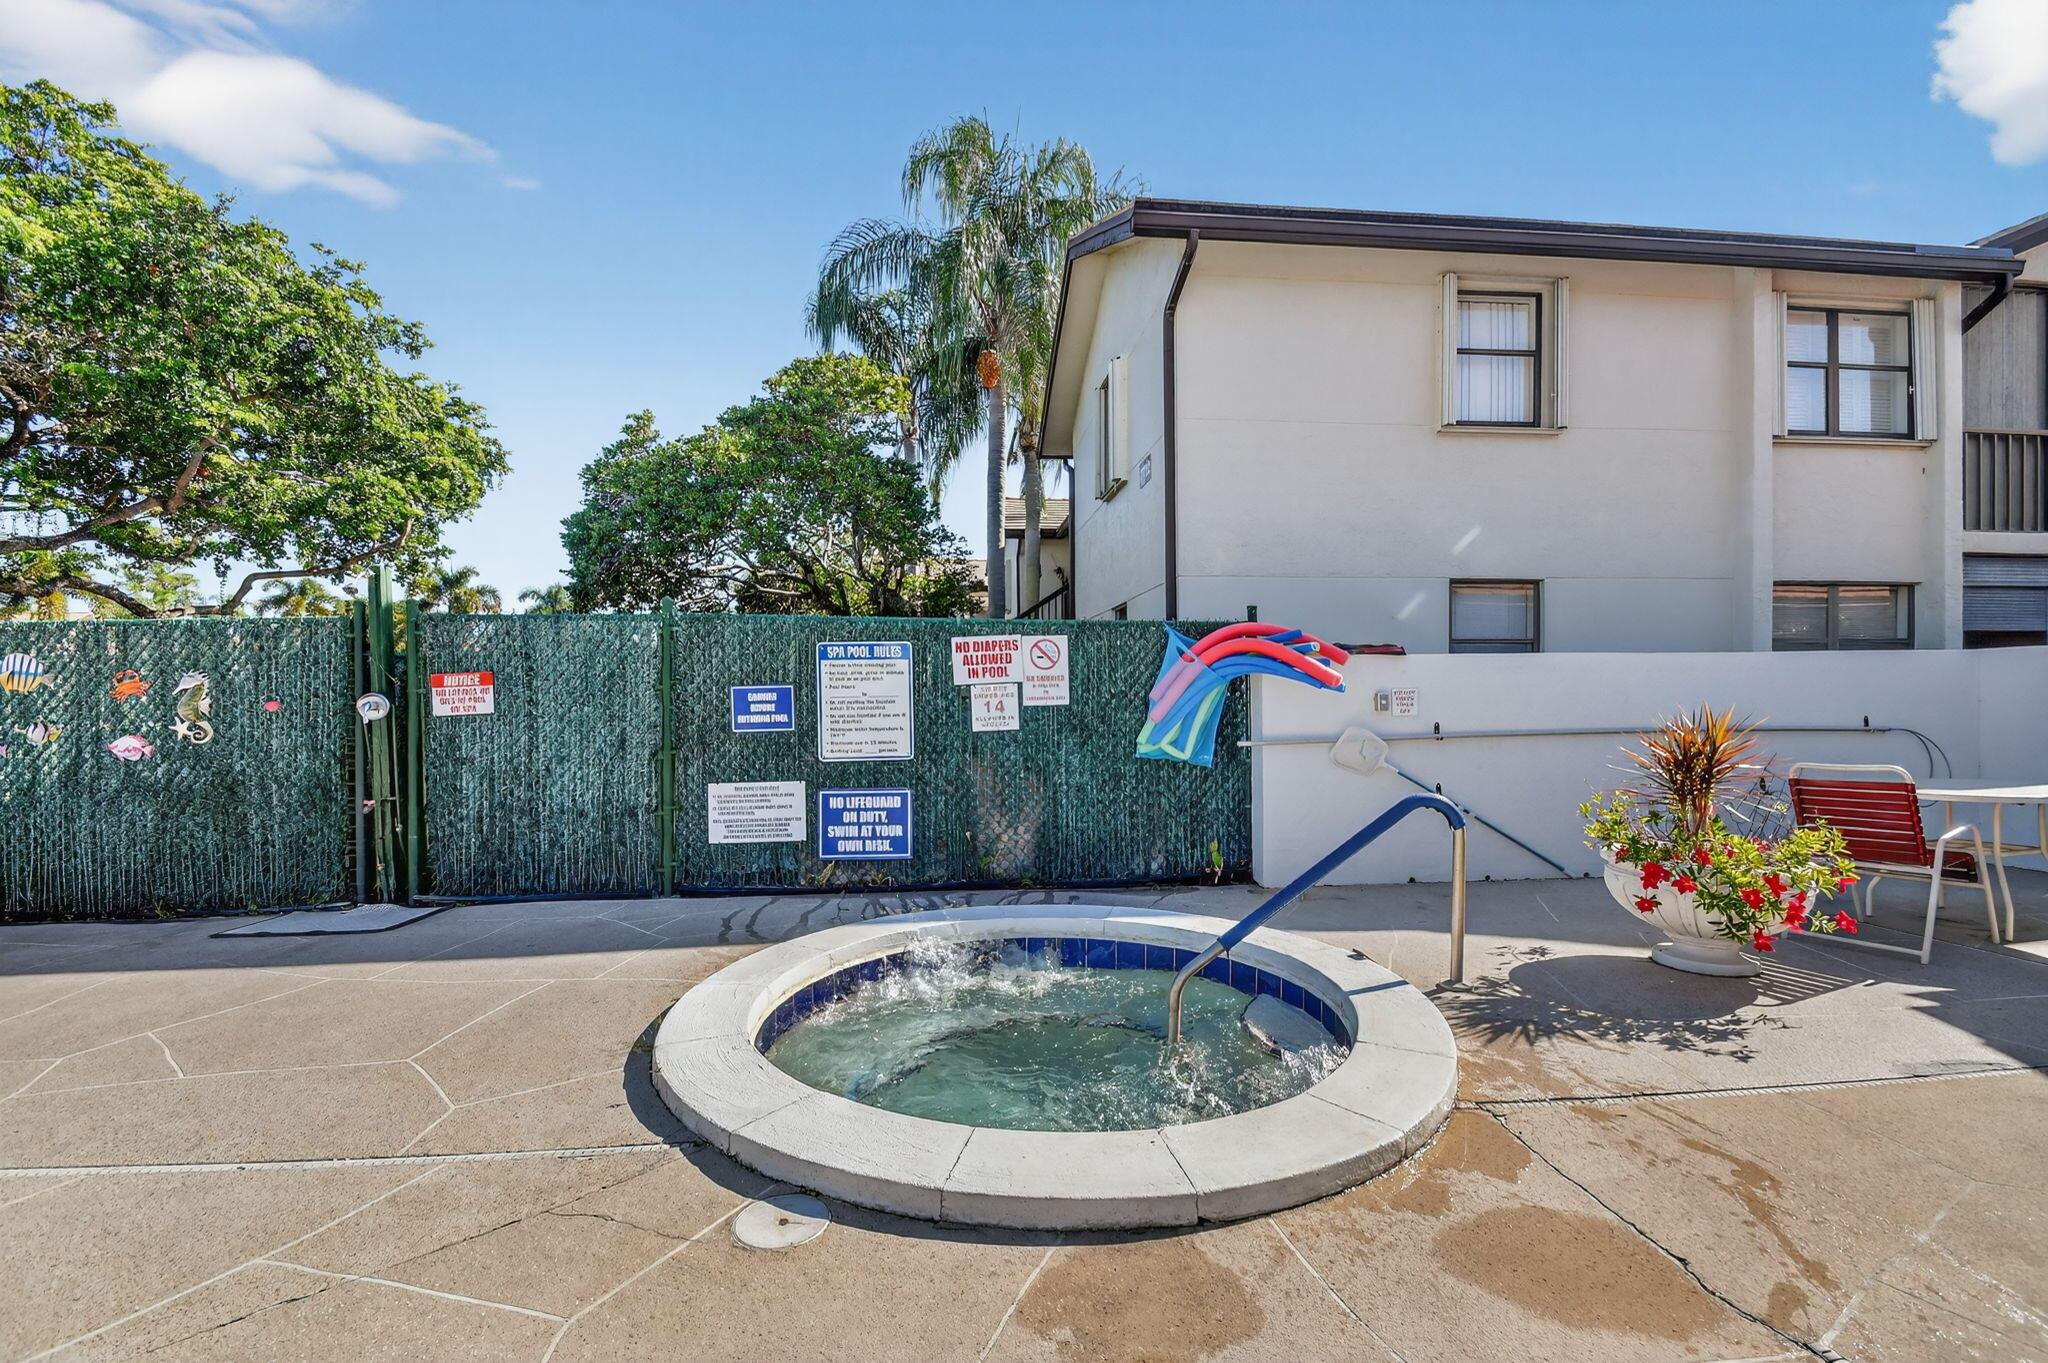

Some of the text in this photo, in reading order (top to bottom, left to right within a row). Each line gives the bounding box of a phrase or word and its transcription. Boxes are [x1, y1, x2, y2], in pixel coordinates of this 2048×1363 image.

[827, 646, 845, 658] SPA
[847, 646, 872, 658] POOL
[955, 640, 1019, 653] NO DIAPERS
[962, 653, 1012, 666] ALLOWED
[968, 666, 1010, 678] IN POOL
[829, 796, 902, 809] NO LIFEGUARD
[843, 811, 857, 823] ON
[827, 824, 903, 837] SWIM AT YOUR
[837, 840, 863, 852] OWN
